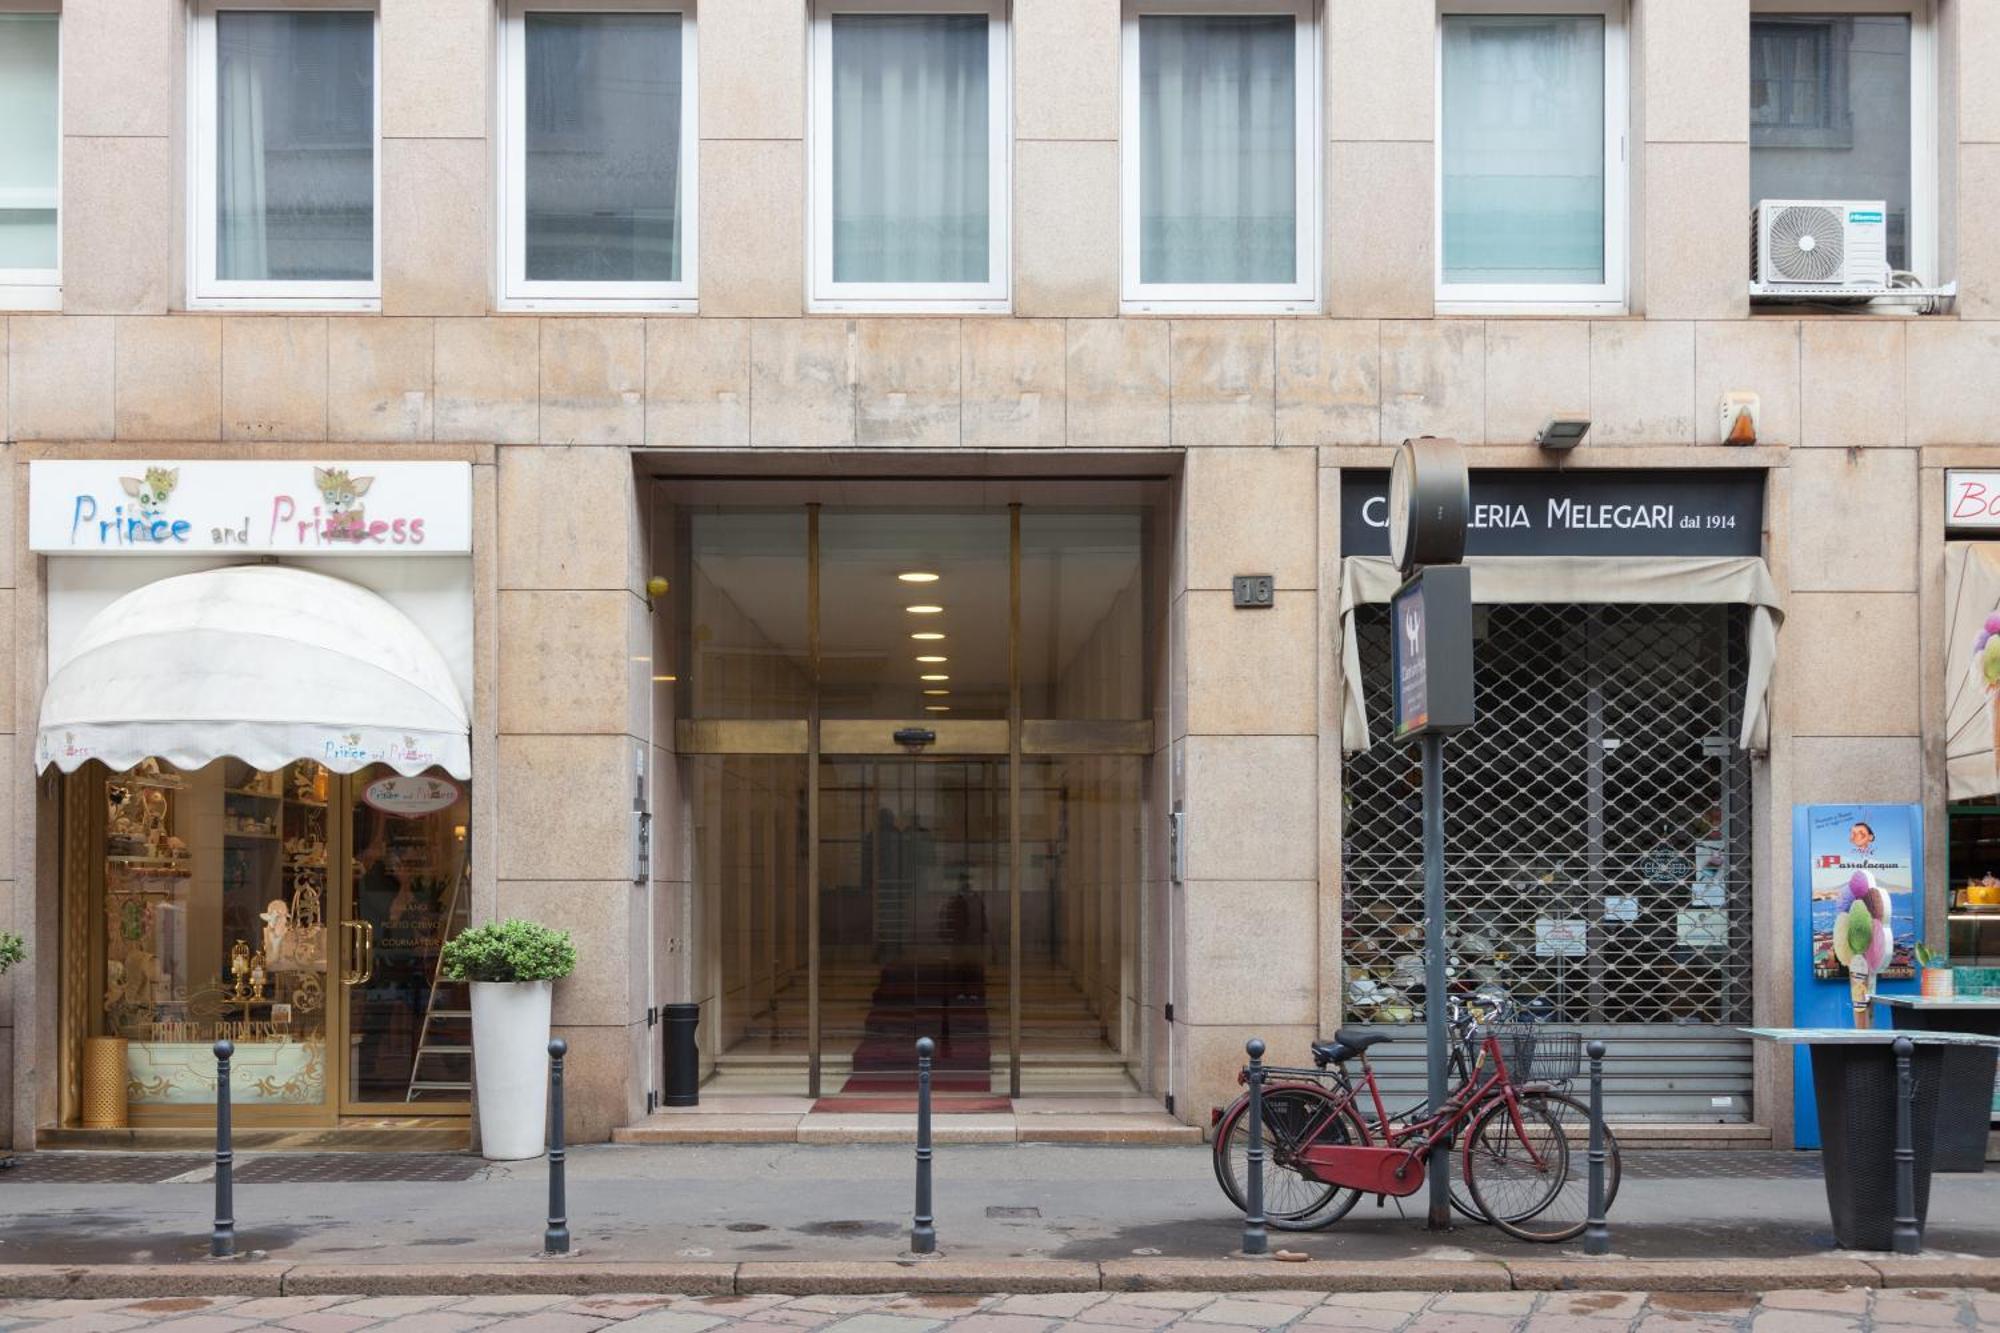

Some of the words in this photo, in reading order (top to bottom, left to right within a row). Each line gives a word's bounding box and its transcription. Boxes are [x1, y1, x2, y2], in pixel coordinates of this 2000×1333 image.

[72, 495, 192, 545] Prince
[210, 516, 249, 544] and
[1547, 497, 1674, 529] MELEGARI
[1679, 515, 1701, 529] dal
[1705, 515, 1737, 529] 1914
